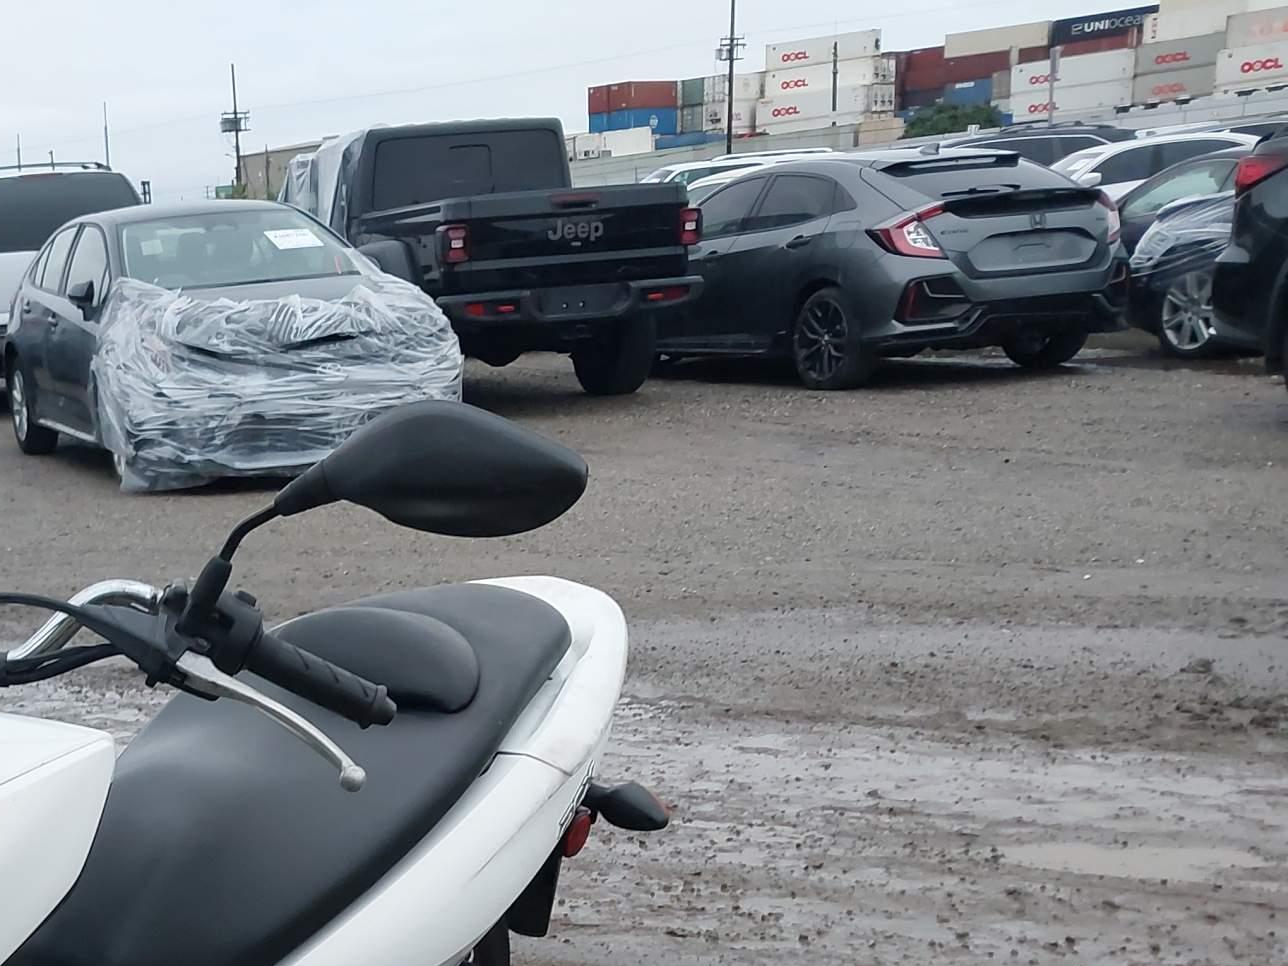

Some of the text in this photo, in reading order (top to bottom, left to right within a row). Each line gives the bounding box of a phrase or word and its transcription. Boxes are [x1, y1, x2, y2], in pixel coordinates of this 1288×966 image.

[781, 51, 809, 63] OOCL
[1154, 51, 1191, 64] OOCL
[1240, 58, 1283, 73] OOCL
[781, 79, 809, 90] OOCL
[772, 106, 800, 117] OOCL
[547, 220, 604, 241] Jeep
